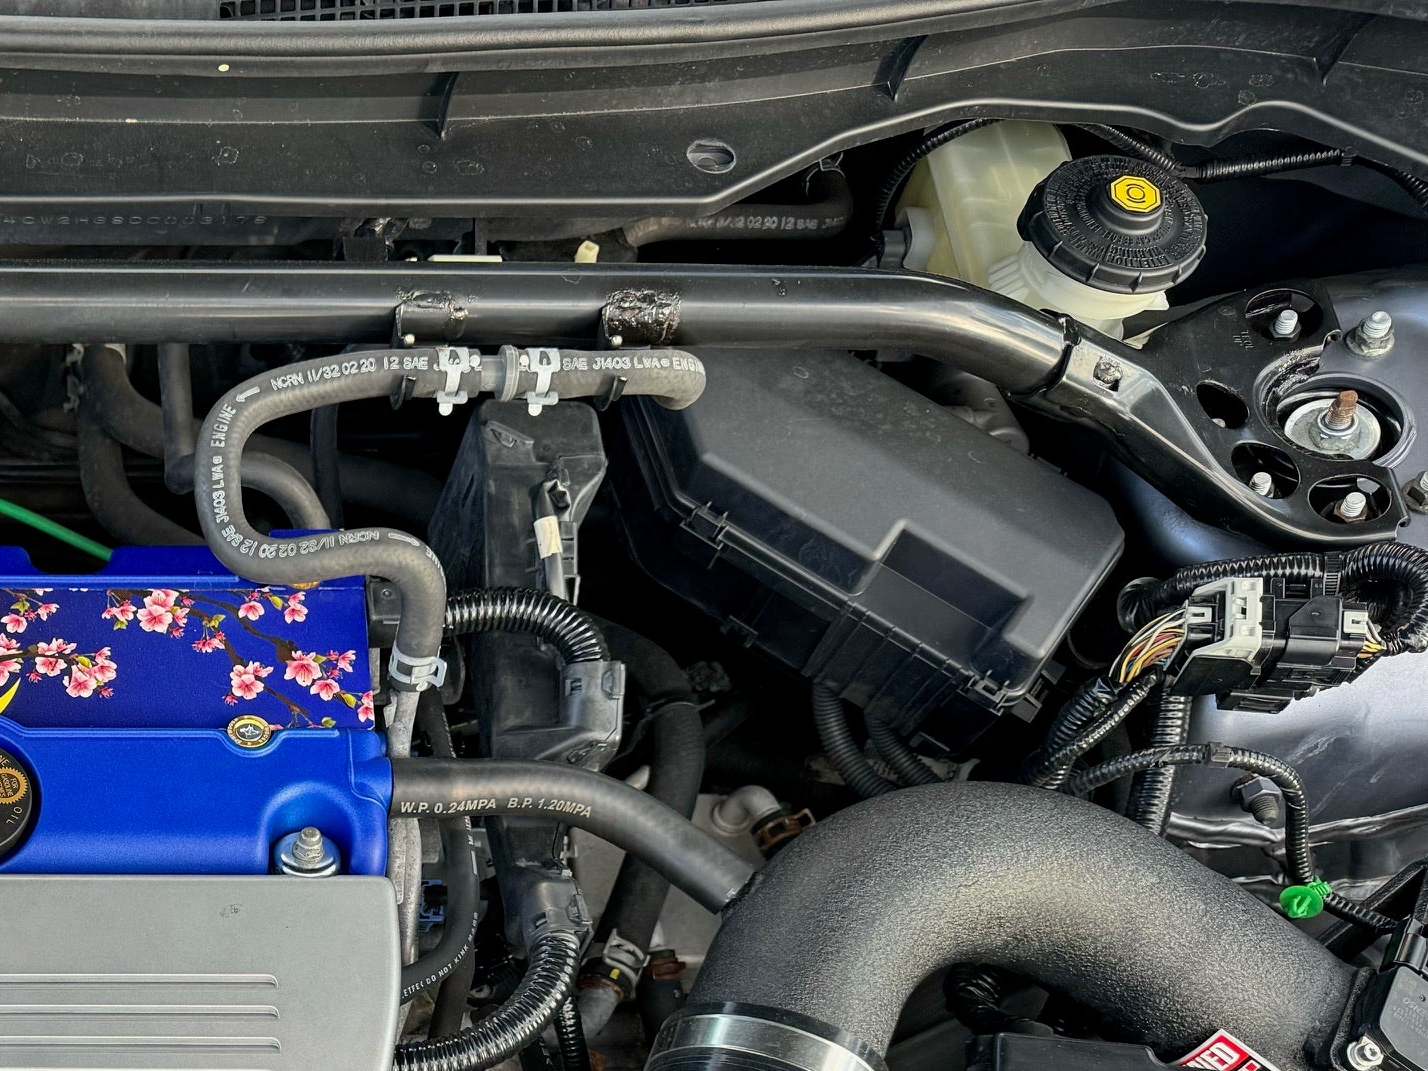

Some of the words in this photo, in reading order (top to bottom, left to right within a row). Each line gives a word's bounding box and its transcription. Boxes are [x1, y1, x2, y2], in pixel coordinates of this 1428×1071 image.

[271, 372, 305, 392] NCRN
[341, 361, 359, 376] 02
[358, 357, 378, 373] 20
[383, 356, 400, 370] 12
[403, 356, 429, 371] SAE
[562, 357, 588, 371] SAE
[592, 356, 632, 370] J1403
[210, 403, 237, 449] ENGINE
[222, 524, 244, 548] SAE
[239, 539, 259, 557] 12
[258, 543, 277, 559] 20
[278, 542, 297, 558] 02
[5, 805, 23, 825] OIL
[400, 801, 430, 814] W.P.
[433, 798, 498, 815] 0.24MPA
[507, 797, 533, 810] B.P.
[537, 798, 593, 819] 1.20MPA
[425, 974, 437, 986] DO
[438, 962, 453, 978] NOT
